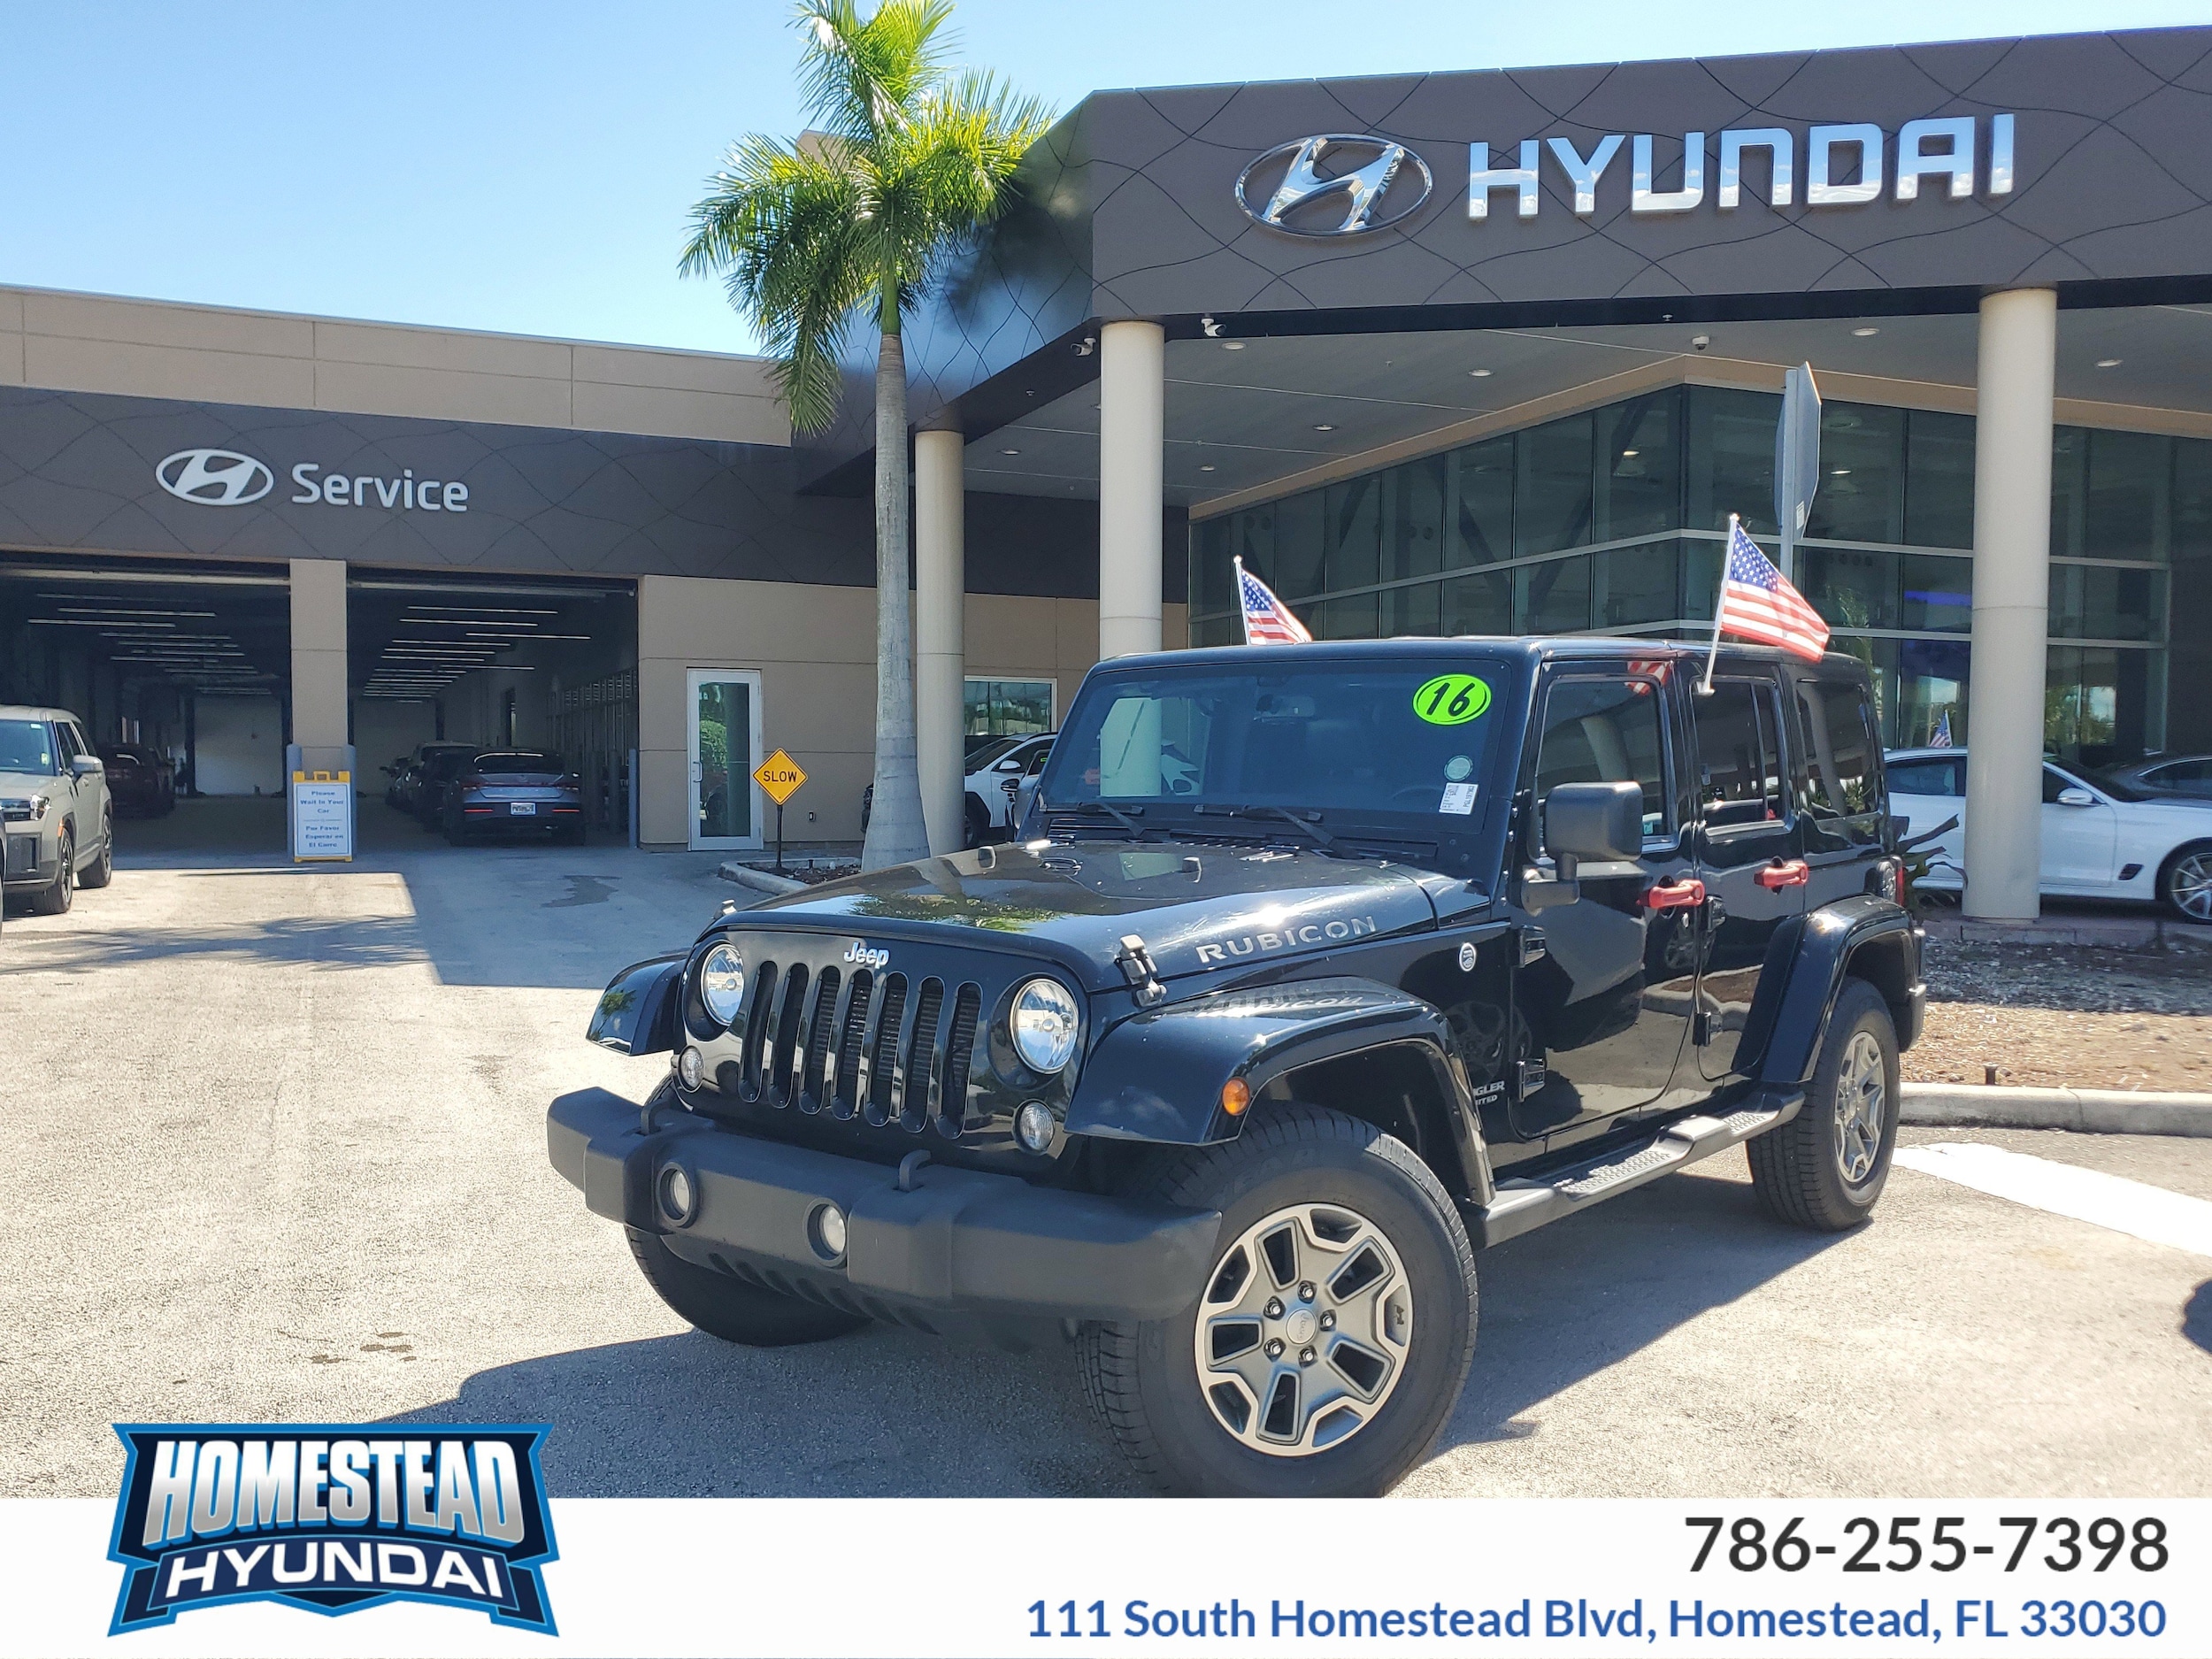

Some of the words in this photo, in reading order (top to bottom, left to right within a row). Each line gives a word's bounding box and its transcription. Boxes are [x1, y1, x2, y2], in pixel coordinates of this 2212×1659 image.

[1469, 113, 2015, 219] HYUNDAI
[291, 463, 469, 511] Service
[1425, 682, 1476, 717] 16
[763, 770, 797, 782] SLOW
[843, 941, 890, 970] Jeep
[1195, 916, 1377, 964] RUBICON
